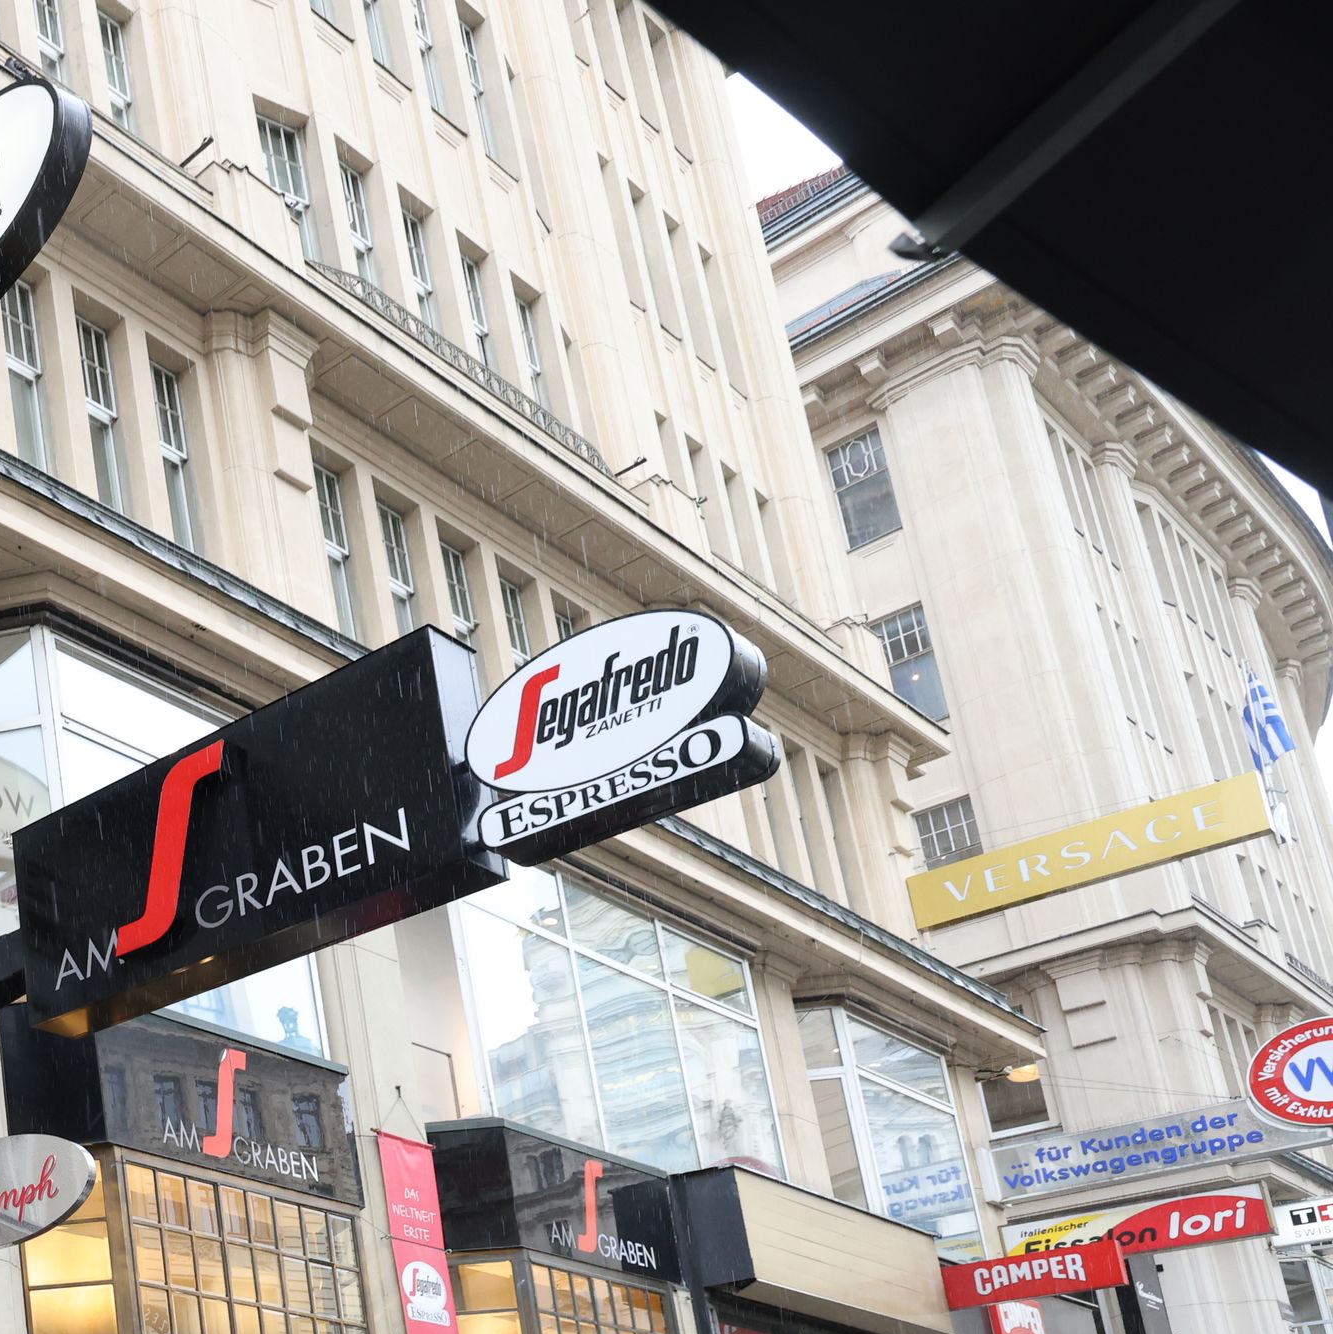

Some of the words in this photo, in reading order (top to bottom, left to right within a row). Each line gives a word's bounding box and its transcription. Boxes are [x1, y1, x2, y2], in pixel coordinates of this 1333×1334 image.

[494, 625, 699, 780] Segafredo
[586, 697, 661, 739] ZANETTI
[495, 729, 721, 841] ESPRESSO
[195, 807, 411, 929] GRABEN
[944, 801, 1225, 902] VERSACE
[1264, 1087, 1290, 1107] mit
[163, 1116, 201, 1153] AM
[233, 1135, 320, 1182] GRABEN
[1003, 1130, 1264, 1190] Volkswagengruppe
[1035, 1146, 1072, 1165] für
[1080, 1123, 1182, 1156] Kunden
[1190, 1112, 1238, 1134] der
[392, 1204, 436, 1224] WELTWEIT
[404, 1187, 420, 1202] DAS
[403, 1225, 430, 1242] ERSTE
[551, 1220, 577, 1249] AM
[597, 1233, 657, 1270] GRABEN
[1020, 1221, 1089, 1239] italienischer
[973, 1252, 1087, 1296] CAMPER
